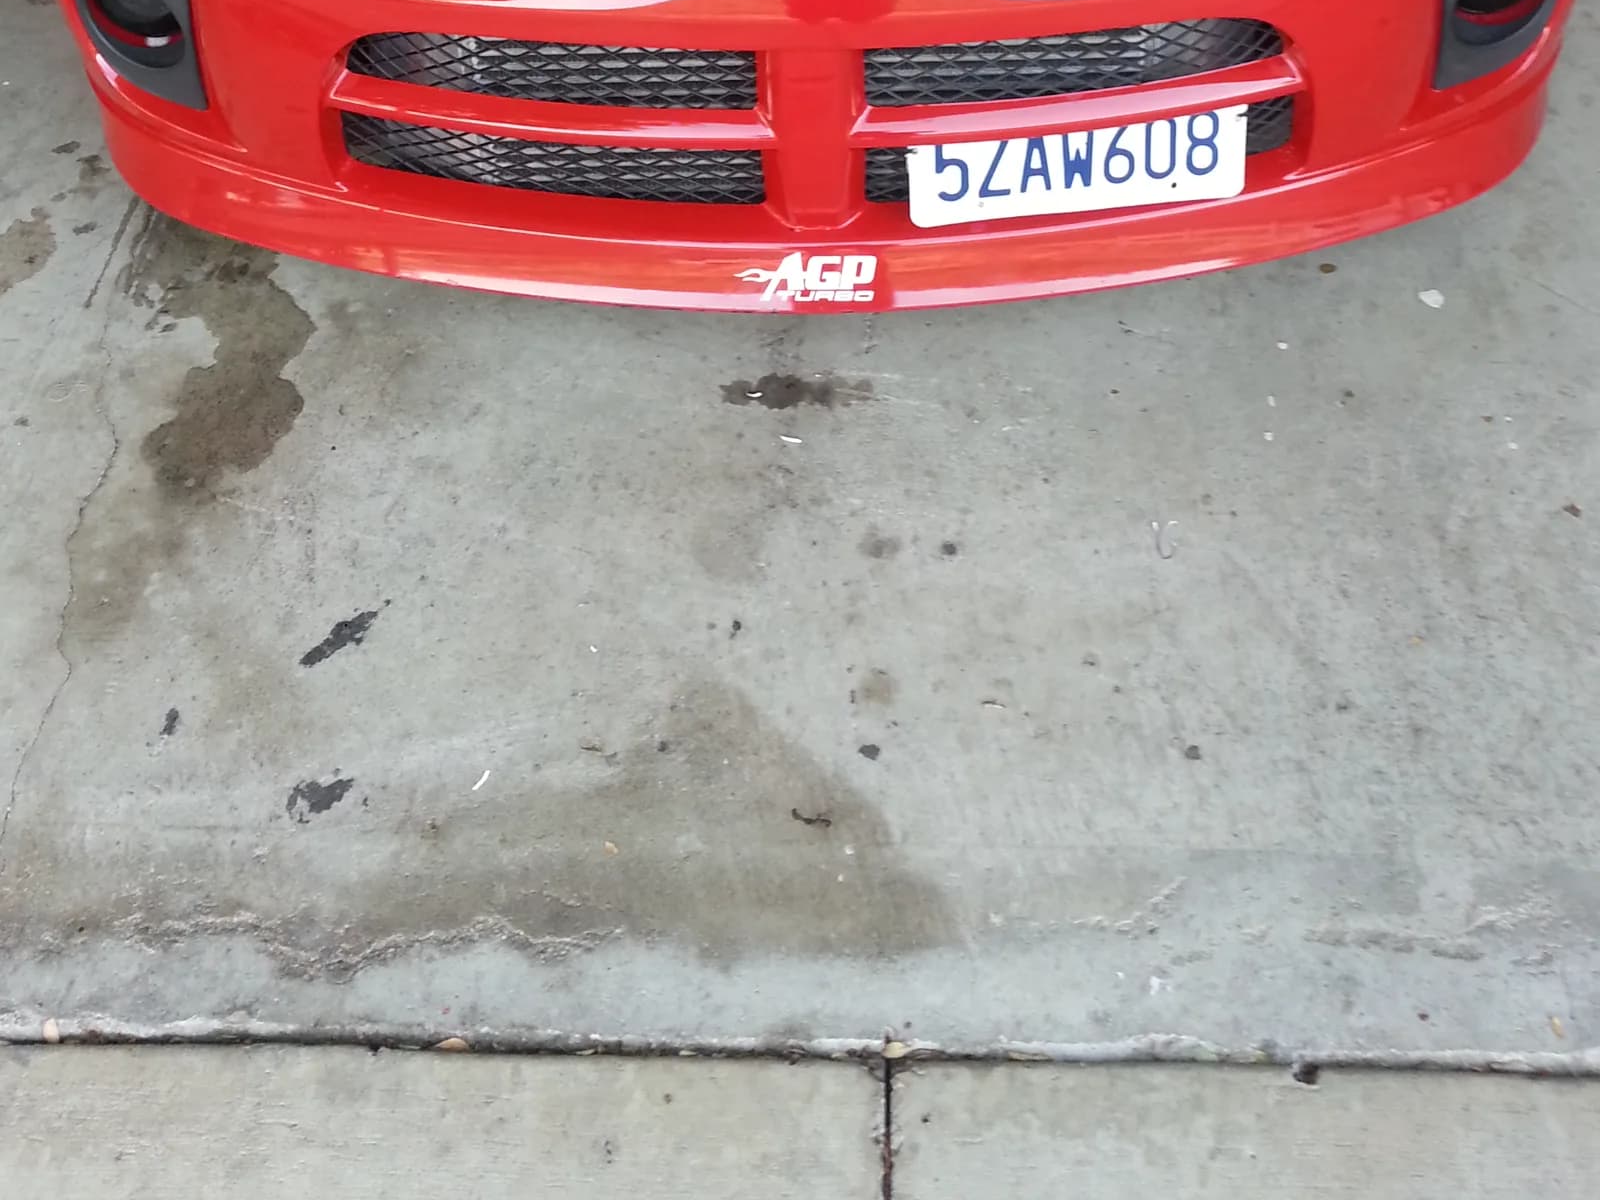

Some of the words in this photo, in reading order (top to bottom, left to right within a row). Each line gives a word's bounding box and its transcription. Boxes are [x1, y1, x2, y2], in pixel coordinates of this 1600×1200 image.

[934, 110, 1220, 202] 5ZAW608
[759, 251, 878, 302] AGP
[775, 289, 875, 302] TURBO
